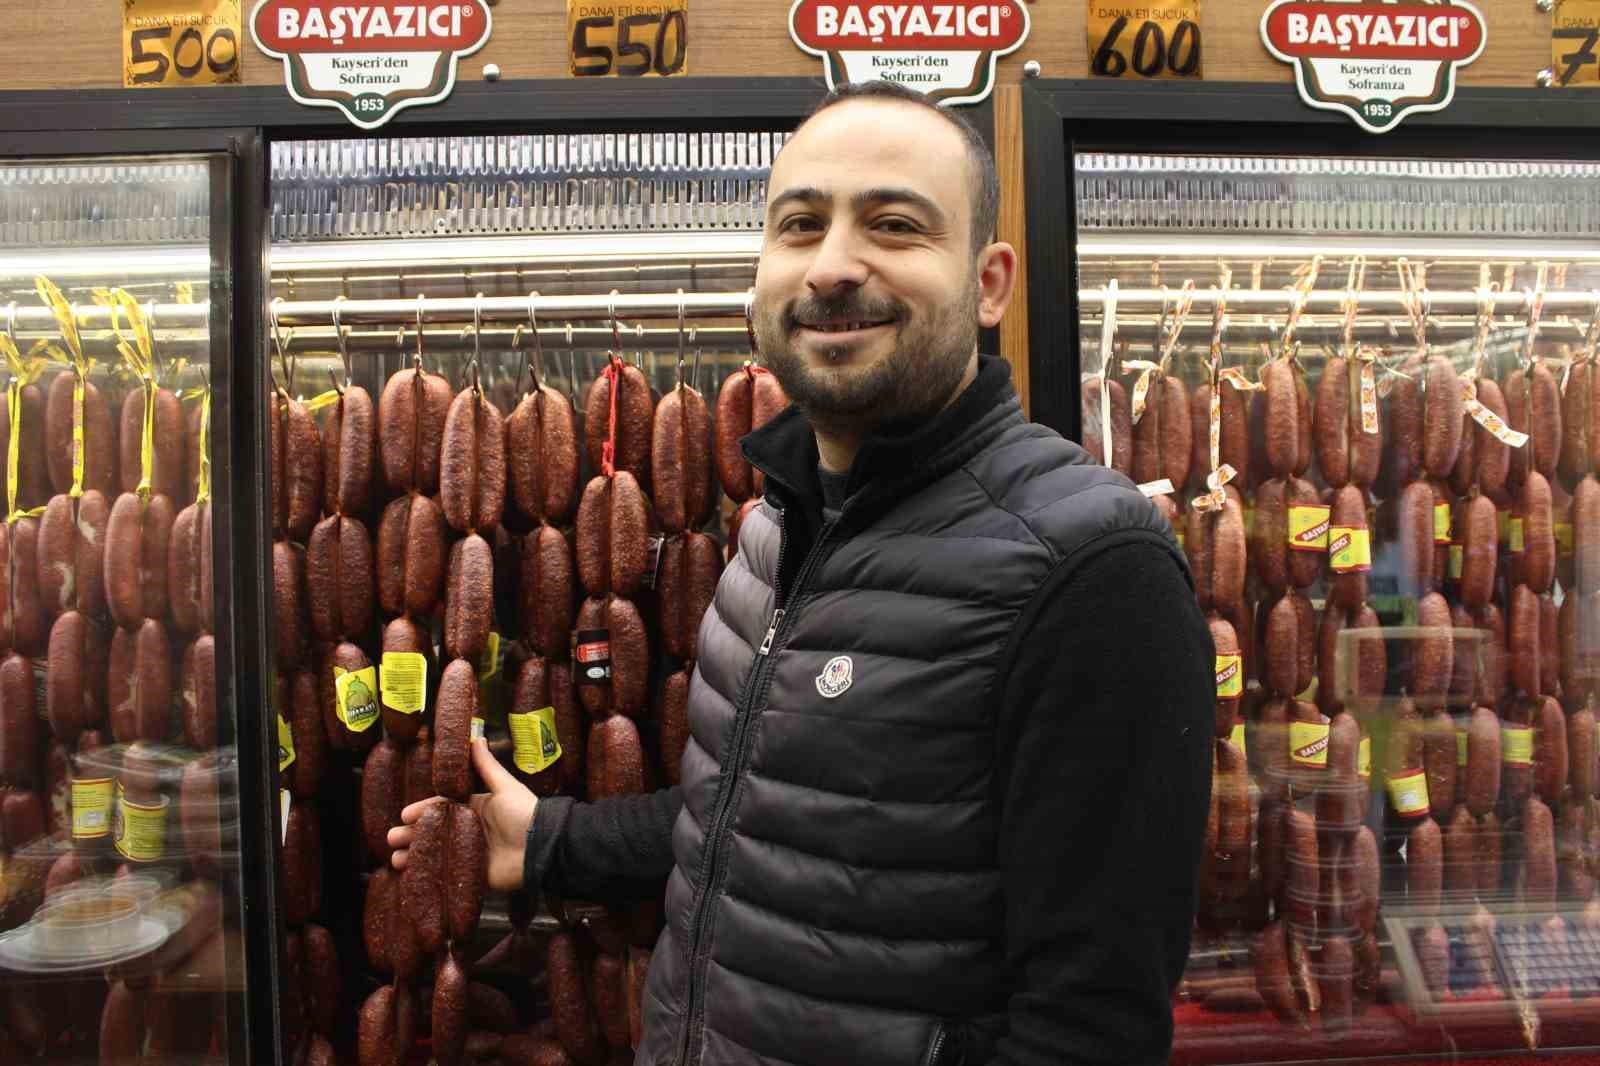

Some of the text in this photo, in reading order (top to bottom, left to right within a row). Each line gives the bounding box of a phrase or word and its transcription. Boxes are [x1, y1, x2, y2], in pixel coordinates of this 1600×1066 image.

[572, 9, 688, 76] 550
[1091, 15, 1202, 78] 600
[131, 26, 238, 82] 500
[331, 56, 408, 70] Kayseri'den
[871, 55, 949, 68] Kayseri'den
[1340, 63, 1412, 76] Kayseri'den
[354, 98, 384, 111] 1953
[1363, 104, 1392, 116] 1953
